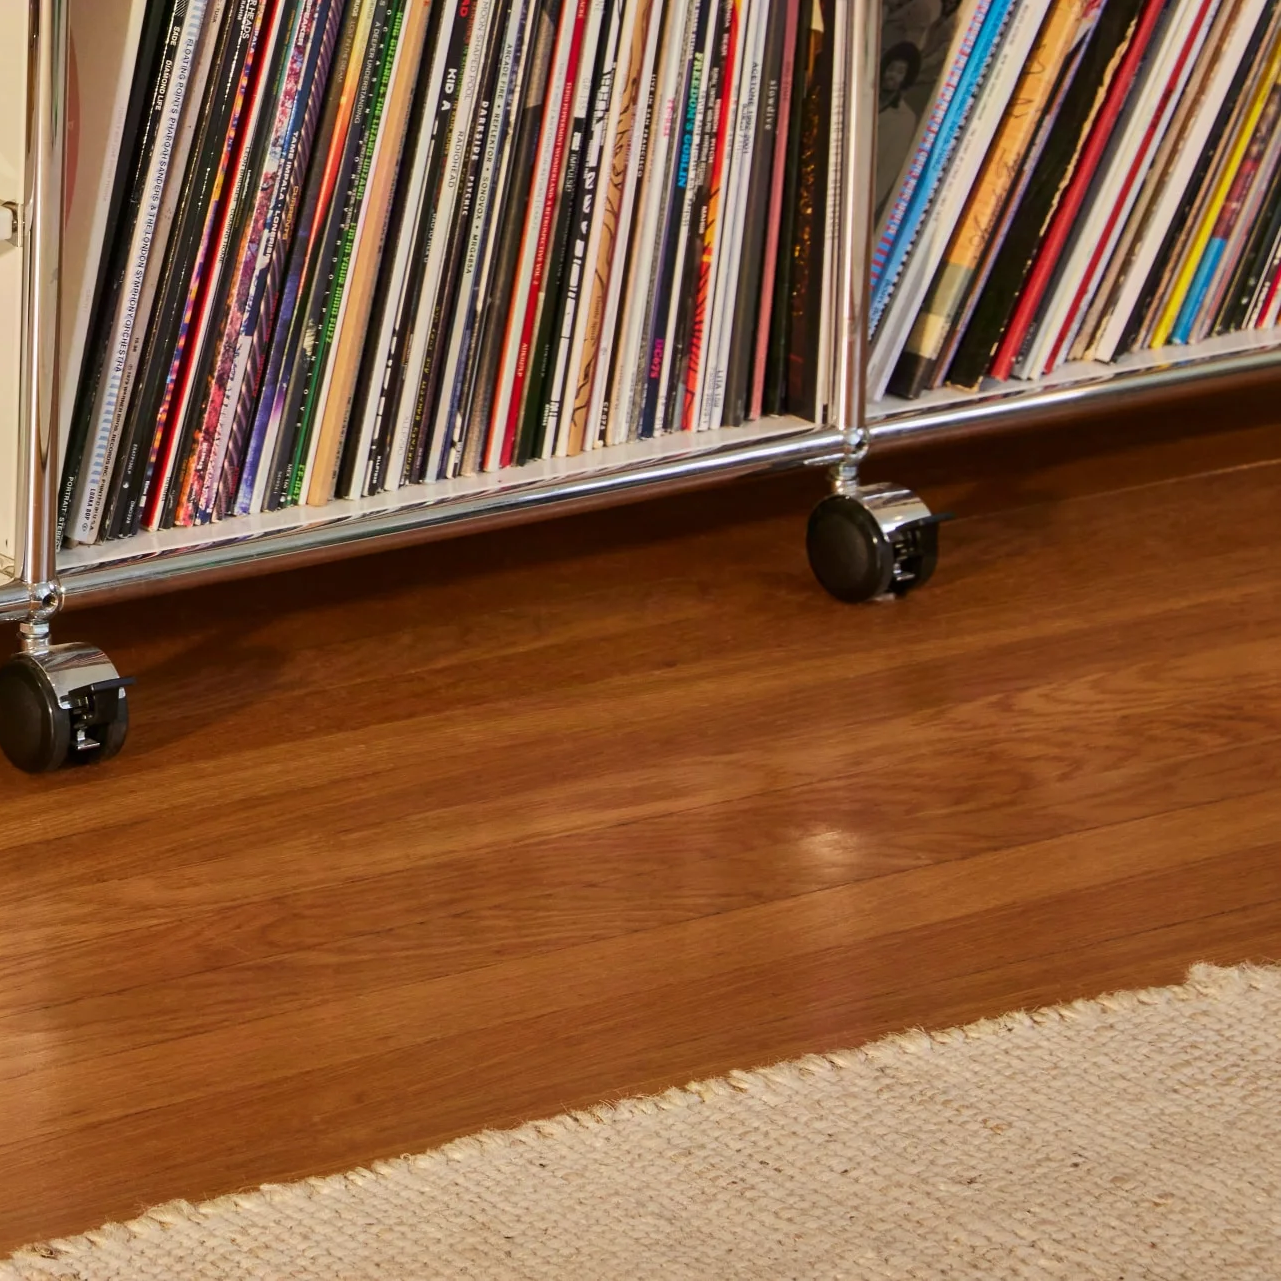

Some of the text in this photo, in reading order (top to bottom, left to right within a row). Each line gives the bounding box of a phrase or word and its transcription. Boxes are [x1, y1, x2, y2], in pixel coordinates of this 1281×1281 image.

[211, 6, 220, 24] TUSK
[241, 6, 256, 40] HEADS
[345, 20, 356, 38] LOST
[374, 20, 382, 28] A
[390, 10, 404, 37] KING
[477, 0, 490, 31] MOON
[367, 27, 380, 59] DEEPER
[380, 37, 398, 84] GIZZARD
[469, 33, 484, 73] SHAPED
[719, 32, 730, 56] BEAR
[154, 24, 181, 112] SADE DIAMOND LIFE
[443, 67, 458, 94] KID
[463, 74, 476, 100] POOL
[649, 72, 657, 91] LIVE
[746, 61, 760, 105] ACETONE
[353, 58, 374, 125] UNDERSTANDING
[373, 95, 385, 116] THE
[439, 99, 451, 112] A
[647, 94, 654, 105] IN
[683, 51, 705, 131] FREEDOM'S
[763, 79, 778, 131] slowdive
[555, 102, 569, 146] PEPPERMINT
[644, 107, 652, 126] SAN
[706, 97, 722, 163] PERSON PITCH
[364, 117, 380, 156] LIZARD
[635, 127, 650, 179] FRANCISCO
[446, 129, 465, 189] RADIOHEAD
[461, 99, 489, 216] DARKSIDE PSYCHIC
[464, 42, 513, 275] ARCADE FIRE REFLEKTOR SONOVOX MRG485A
[563, 152, 578, 193] IMPULSE!
[676, 133, 693, 188] GOBLIN
[263, 129, 299, 263] TAME IMPALA LONERISM
[355, 157, 372, 200] WIZARD
[113, 37, 194, 373] FLOATING POINTS PHAROAH SANDERS THE LONDON SYMPHONY ORCHESTRA
[281, 184, 299, 241] CURRENTS
[535, 206, 551, 262] RETROSPECTIVE
[336, 254, 351, 285] YOUR
[324, 316, 337, 344] FUZZ
[104, 432, 117, 465] RECORDS
[60, 475, 74, 512] PORTRAIT
[94, 477, 106, 506] PRINTED
